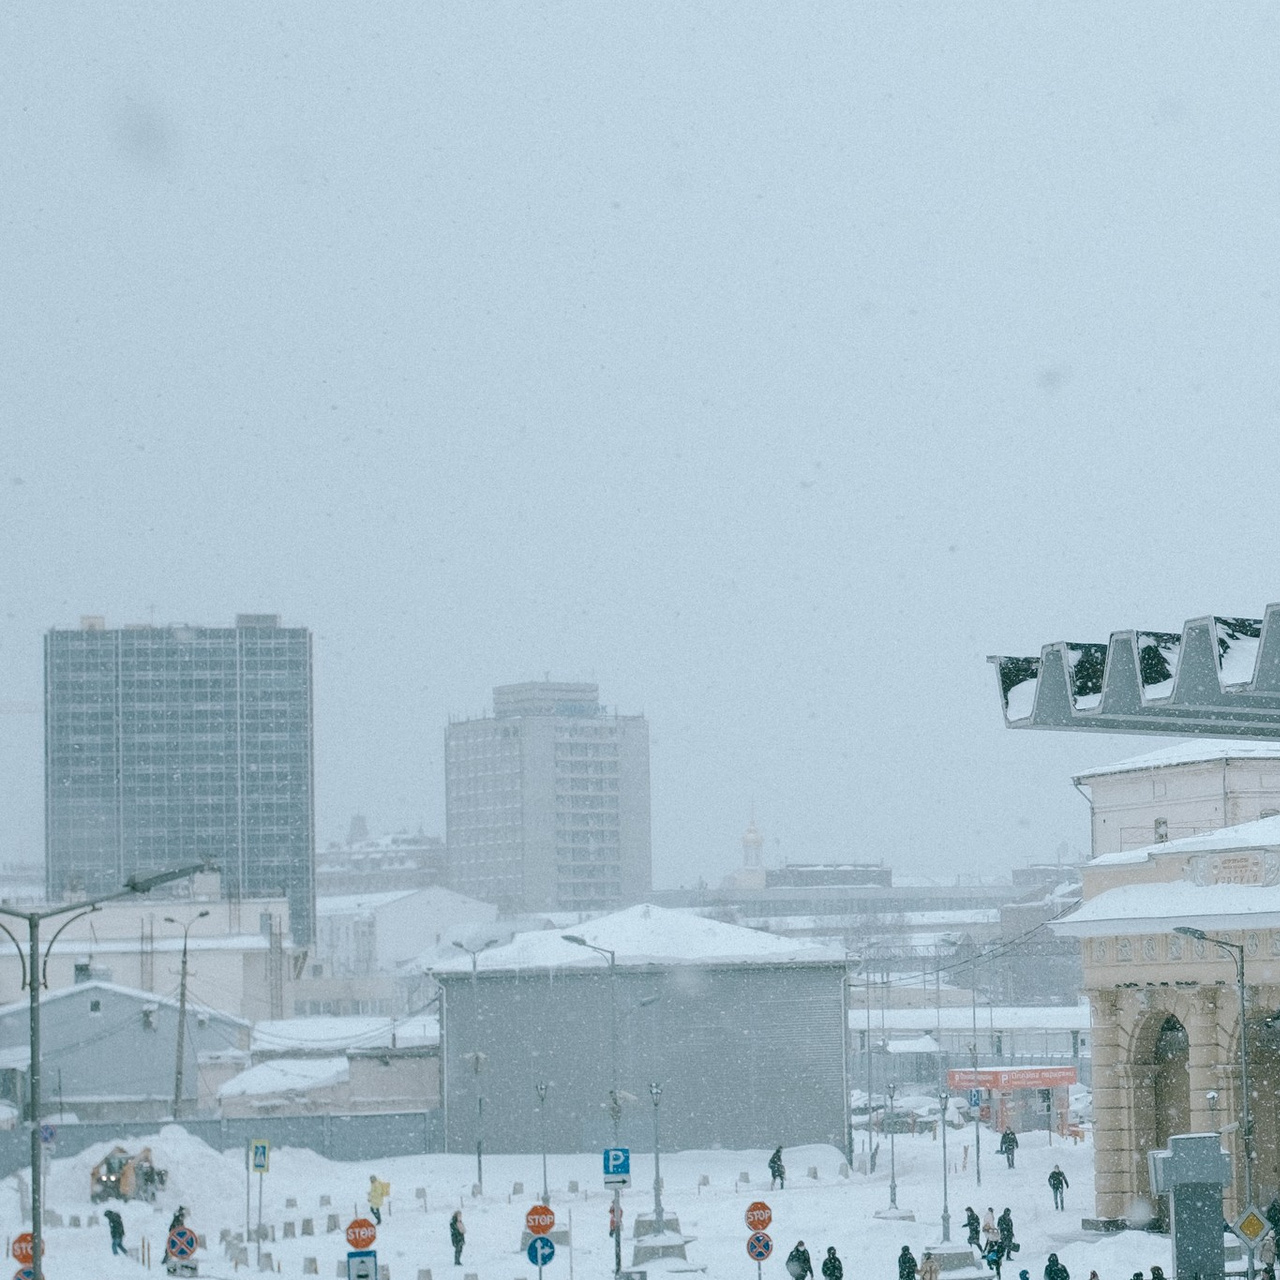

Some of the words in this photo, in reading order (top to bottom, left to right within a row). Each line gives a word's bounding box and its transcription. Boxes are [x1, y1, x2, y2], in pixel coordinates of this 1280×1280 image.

[609, 1150, 624, 1172] P
[527, 1215, 554, 1225] STOP
[748, 1210, 771, 1222] STOP
[347, 1227, 376, 1239] STOP
[14, 1242, 34, 1255] STO
